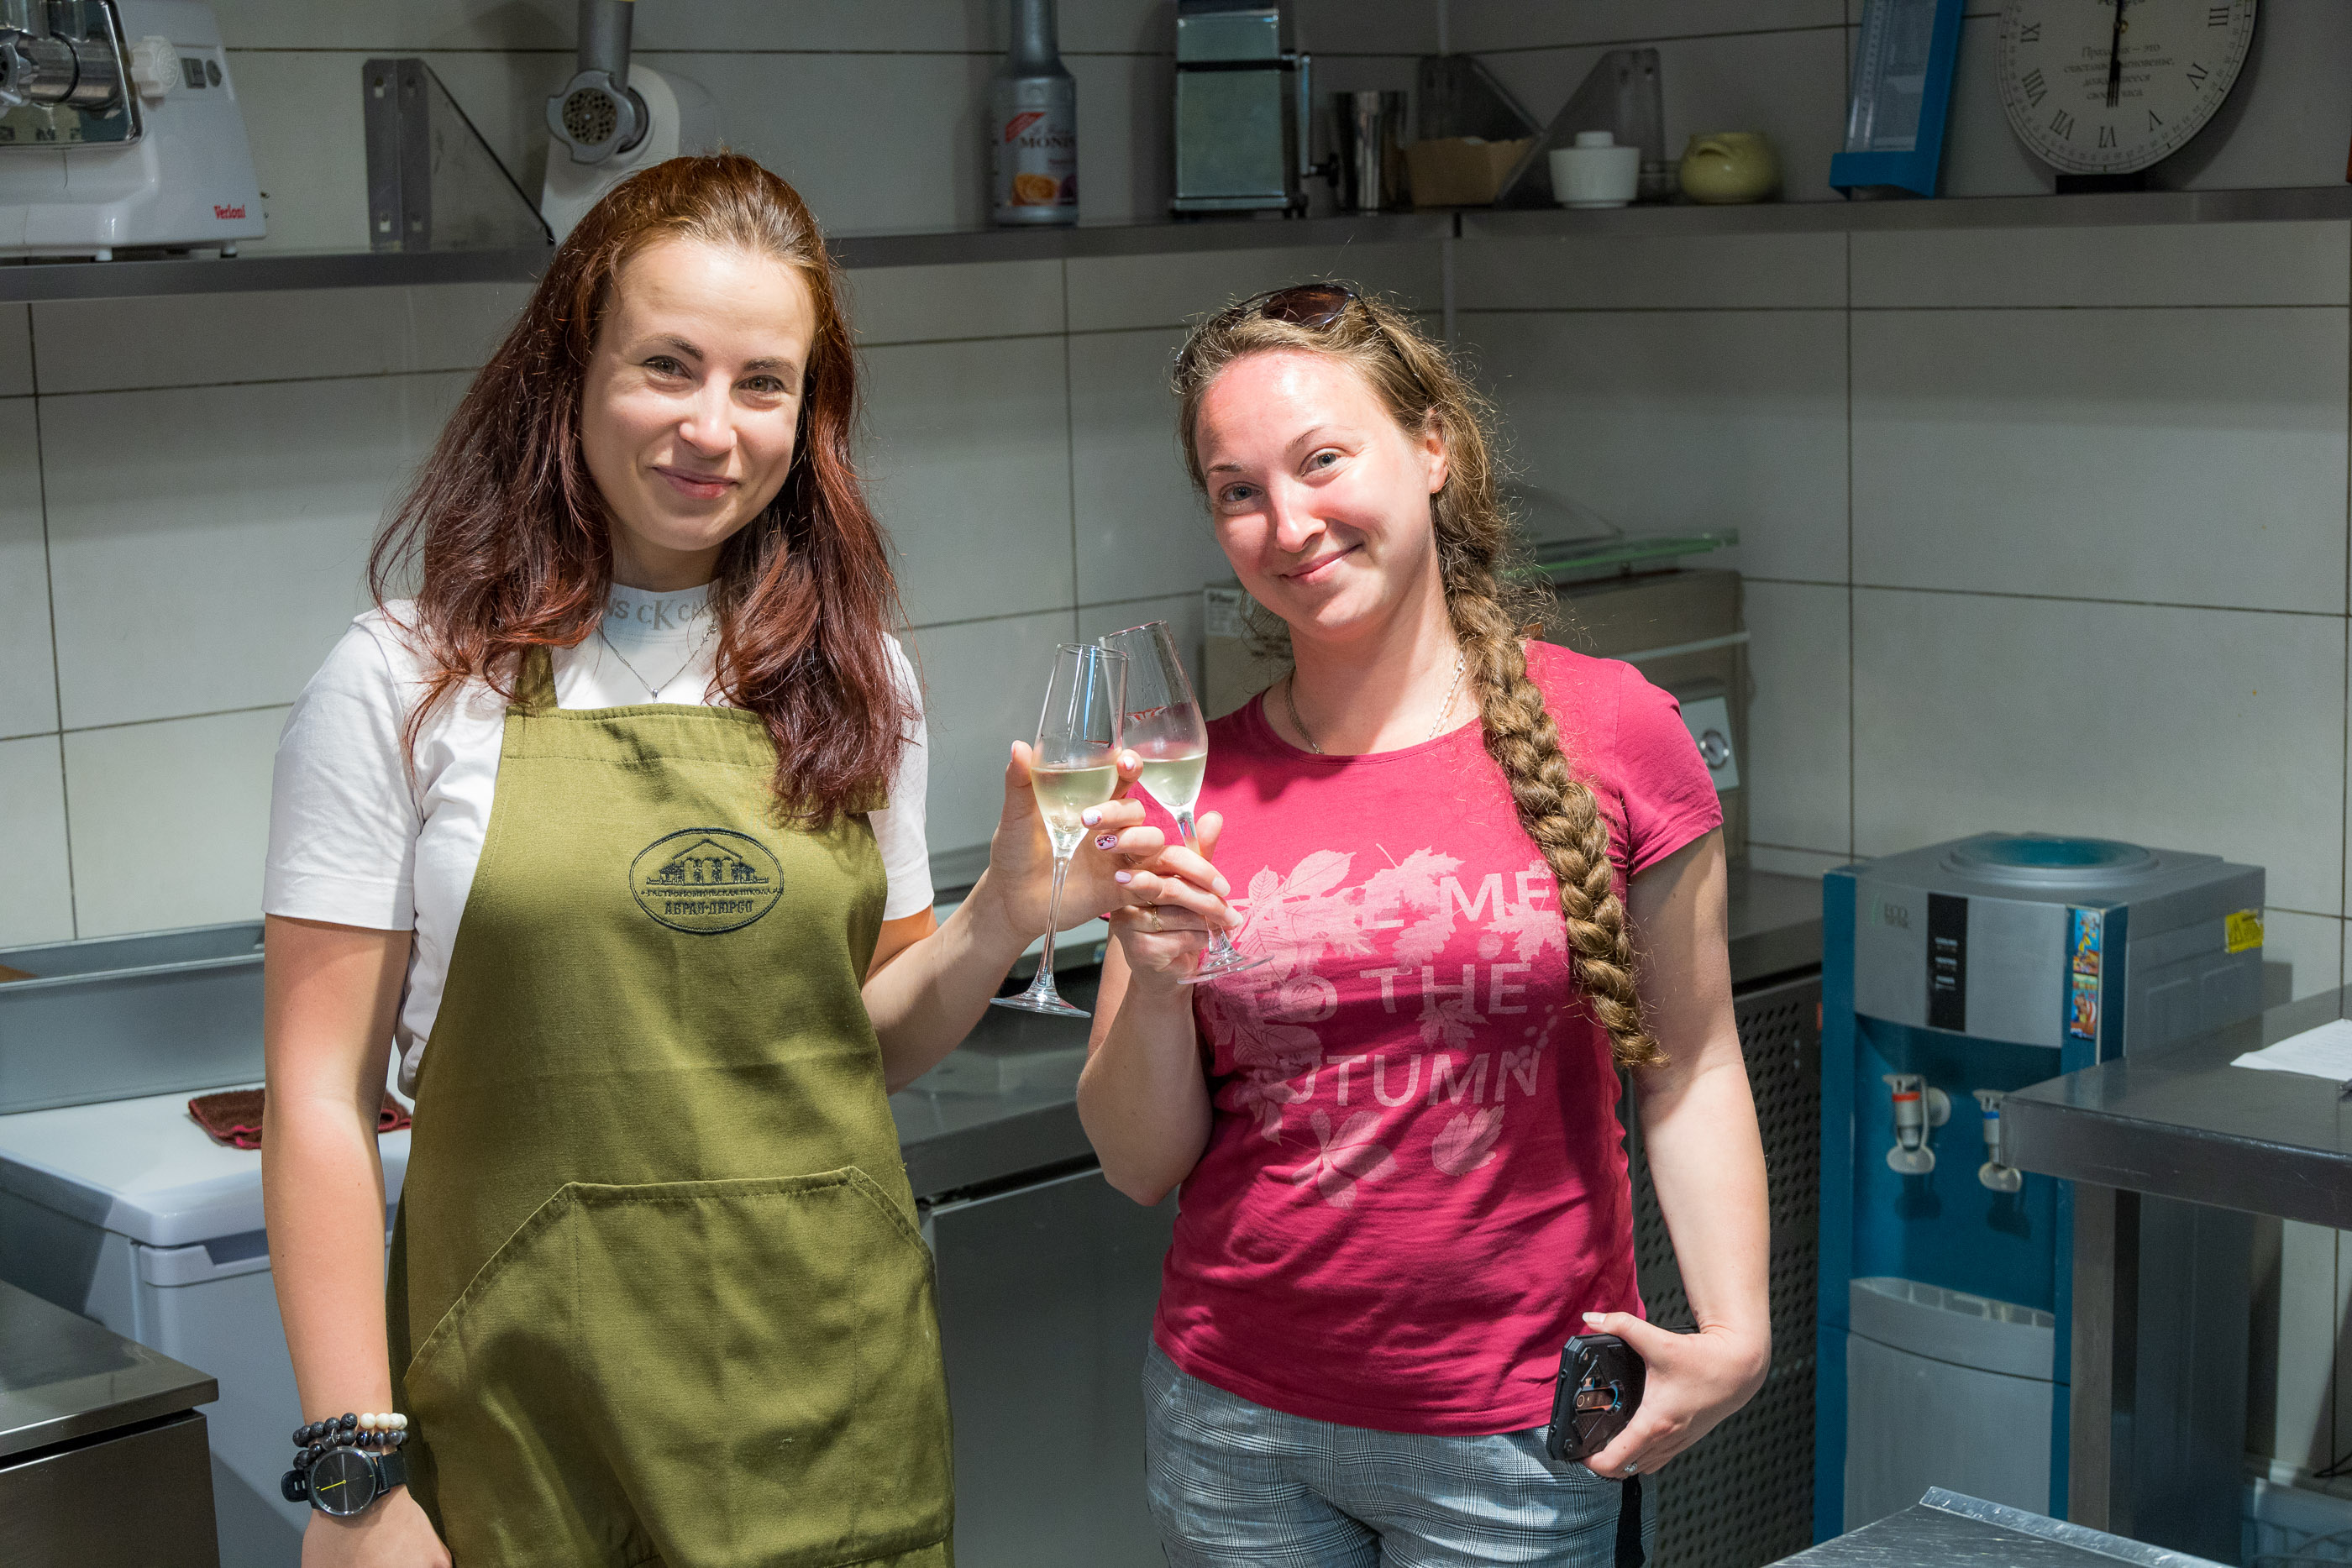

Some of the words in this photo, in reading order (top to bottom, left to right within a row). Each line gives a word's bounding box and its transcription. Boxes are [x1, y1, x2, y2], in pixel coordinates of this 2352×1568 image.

[2208, 6, 2230, 28] III
[2020, 22, 2041, 43] IX
[2021, 68, 2048, 108] VIII
[2187, 62, 2208, 91] IV
[2050, 109, 2075, 141] VII
[2098, 125, 2117, 149] VI
[1439, 870, 1557, 922] ME
[1359, 962, 1531, 1015] THE
